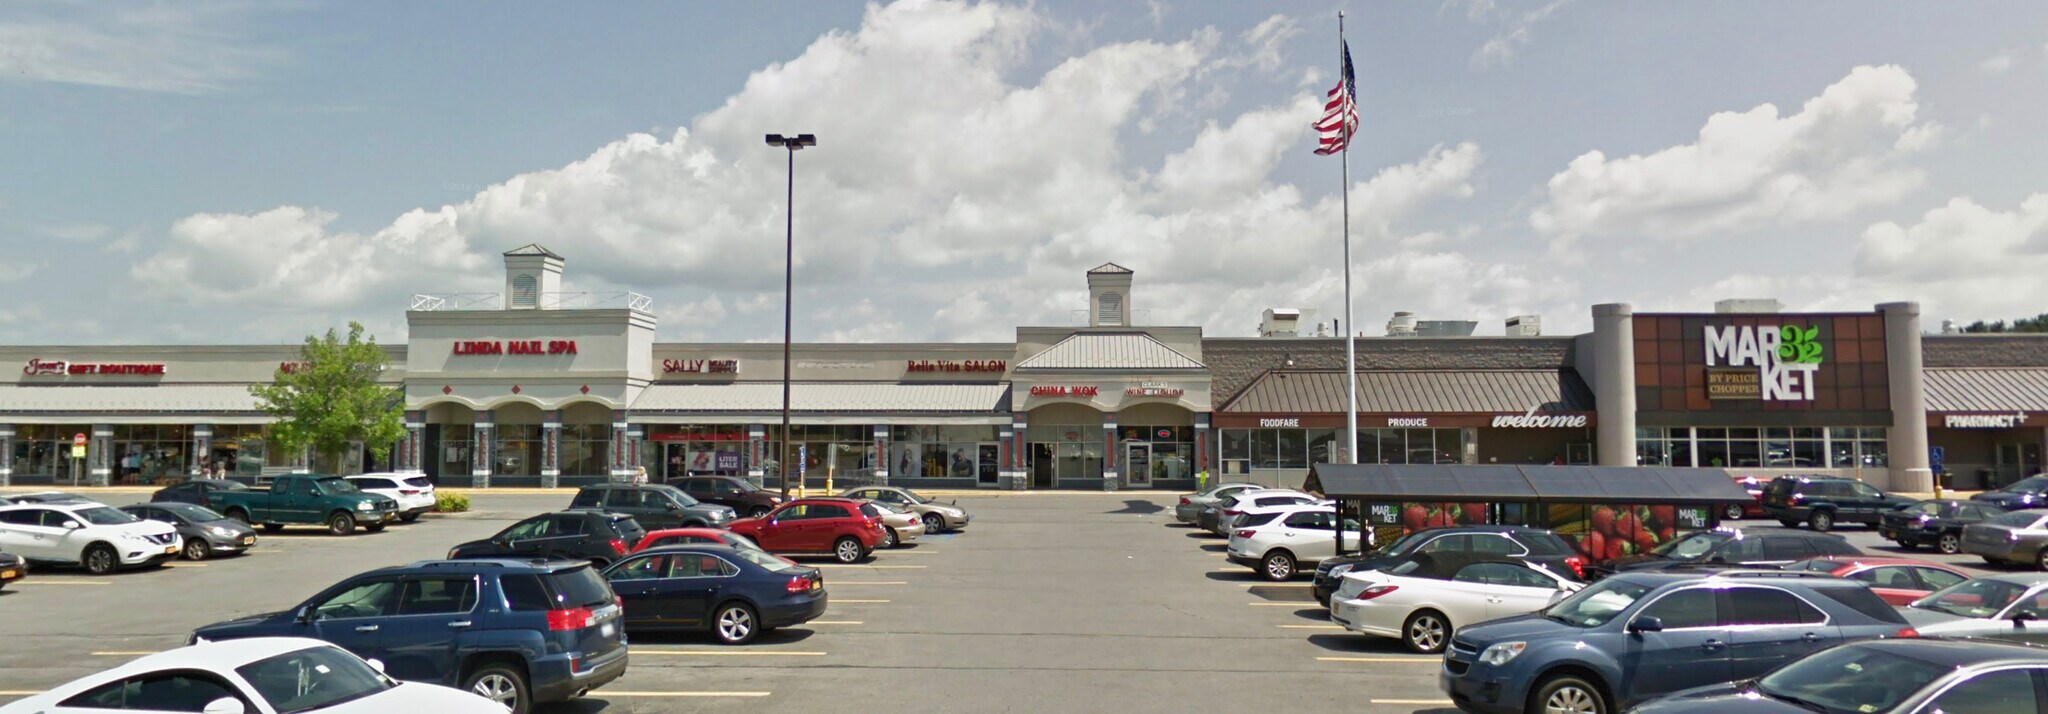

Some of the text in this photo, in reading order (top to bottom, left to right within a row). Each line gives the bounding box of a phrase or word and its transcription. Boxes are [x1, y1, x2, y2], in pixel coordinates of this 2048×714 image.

[454, 340, 577, 356] LINDA NAIL SPA
[1704, 325, 1781, 366] MAR
[67, 364, 97, 375] GIFT
[99, 364, 166, 376] BOUTIQUE
[663, 359, 704, 374] SALLY
[907, 360, 1006, 372] Bella Vita SALON
[1725, 374, 1759, 383] PRICE
[1760, 362, 1819, 401] KET
[1030, 386, 1098, 397] CHINA WOK
[1125, 388, 1184, 396] WINE LIQUOR
[1709, 384, 1759, 393] CHOPPER
[1260, 418, 1299, 428] FOODFARE
[1388, 418, 1428, 428] PRODUCE
[1491, 406, 1588, 428] welcome
